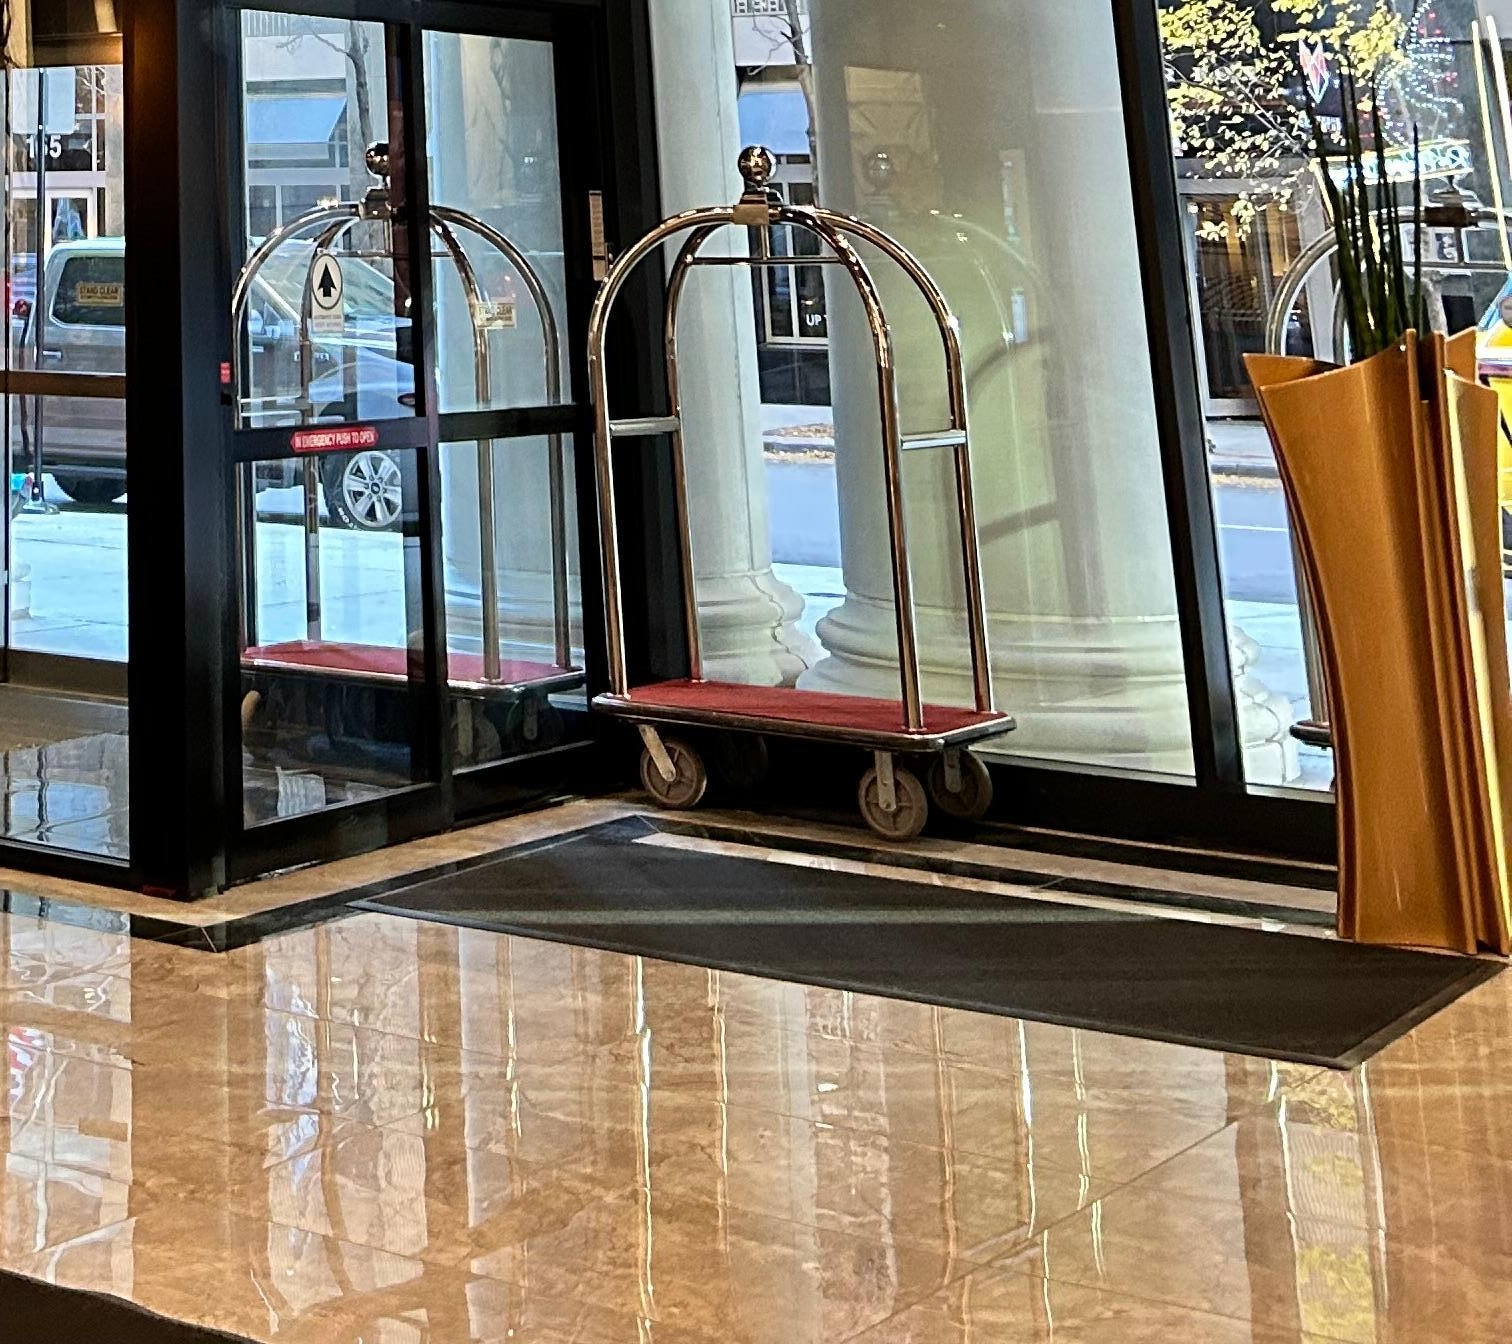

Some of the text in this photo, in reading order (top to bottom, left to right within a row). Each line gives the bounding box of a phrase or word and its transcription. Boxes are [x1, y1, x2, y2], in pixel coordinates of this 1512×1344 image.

[806, 313, 822, 326] UP
[302, 433, 336, 448] EMERGENCY
[336, 432, 351, 445] PUSH
[351, 432, 359, 444] TO
[359, 430, 375, 444] OPEN
